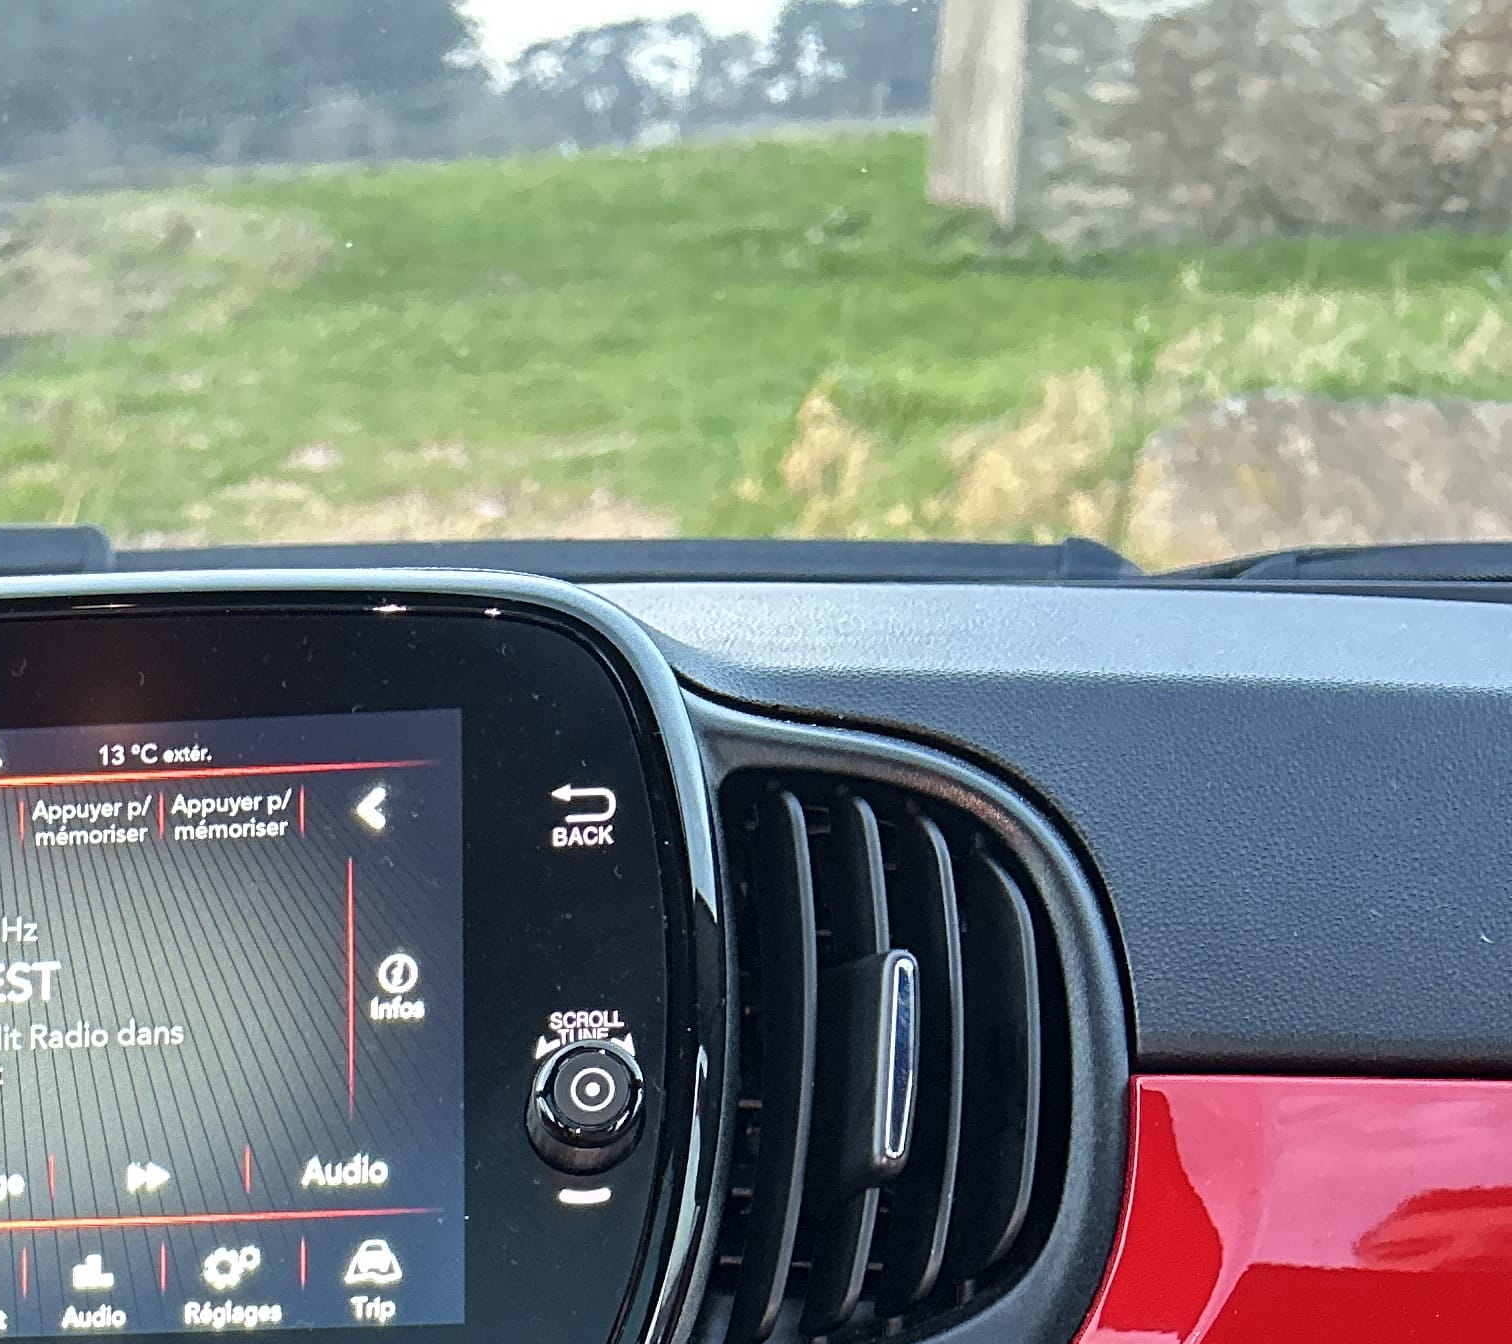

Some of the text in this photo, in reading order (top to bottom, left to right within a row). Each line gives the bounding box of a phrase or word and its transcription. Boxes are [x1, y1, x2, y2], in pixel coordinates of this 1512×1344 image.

[98, 743, 126, 766] 13
[162, 744, 214, 763] extér.
[32, 796, 152, 826] Appuyer p/
[171, 788, 292, 820] Appuyer p/
[34, 826, 148, 847] mémoriser
[174, 818, 289, 842] mémoriser
[552, 825, 615, 848] BACK
[370, 996, 425, 1021] Infos
[548, 1009, 625, 1029] SCROLL
[29, 1021, 109, 1049] Radio
[117, 1019, 185, 1046] dans
[301, 1154, 389, 1187] Audio
[61, 1304, 127, 1329] Audio
[184, 1300, 283, 1330] Réglages
[351, 1295, 396, 1324] Trip
